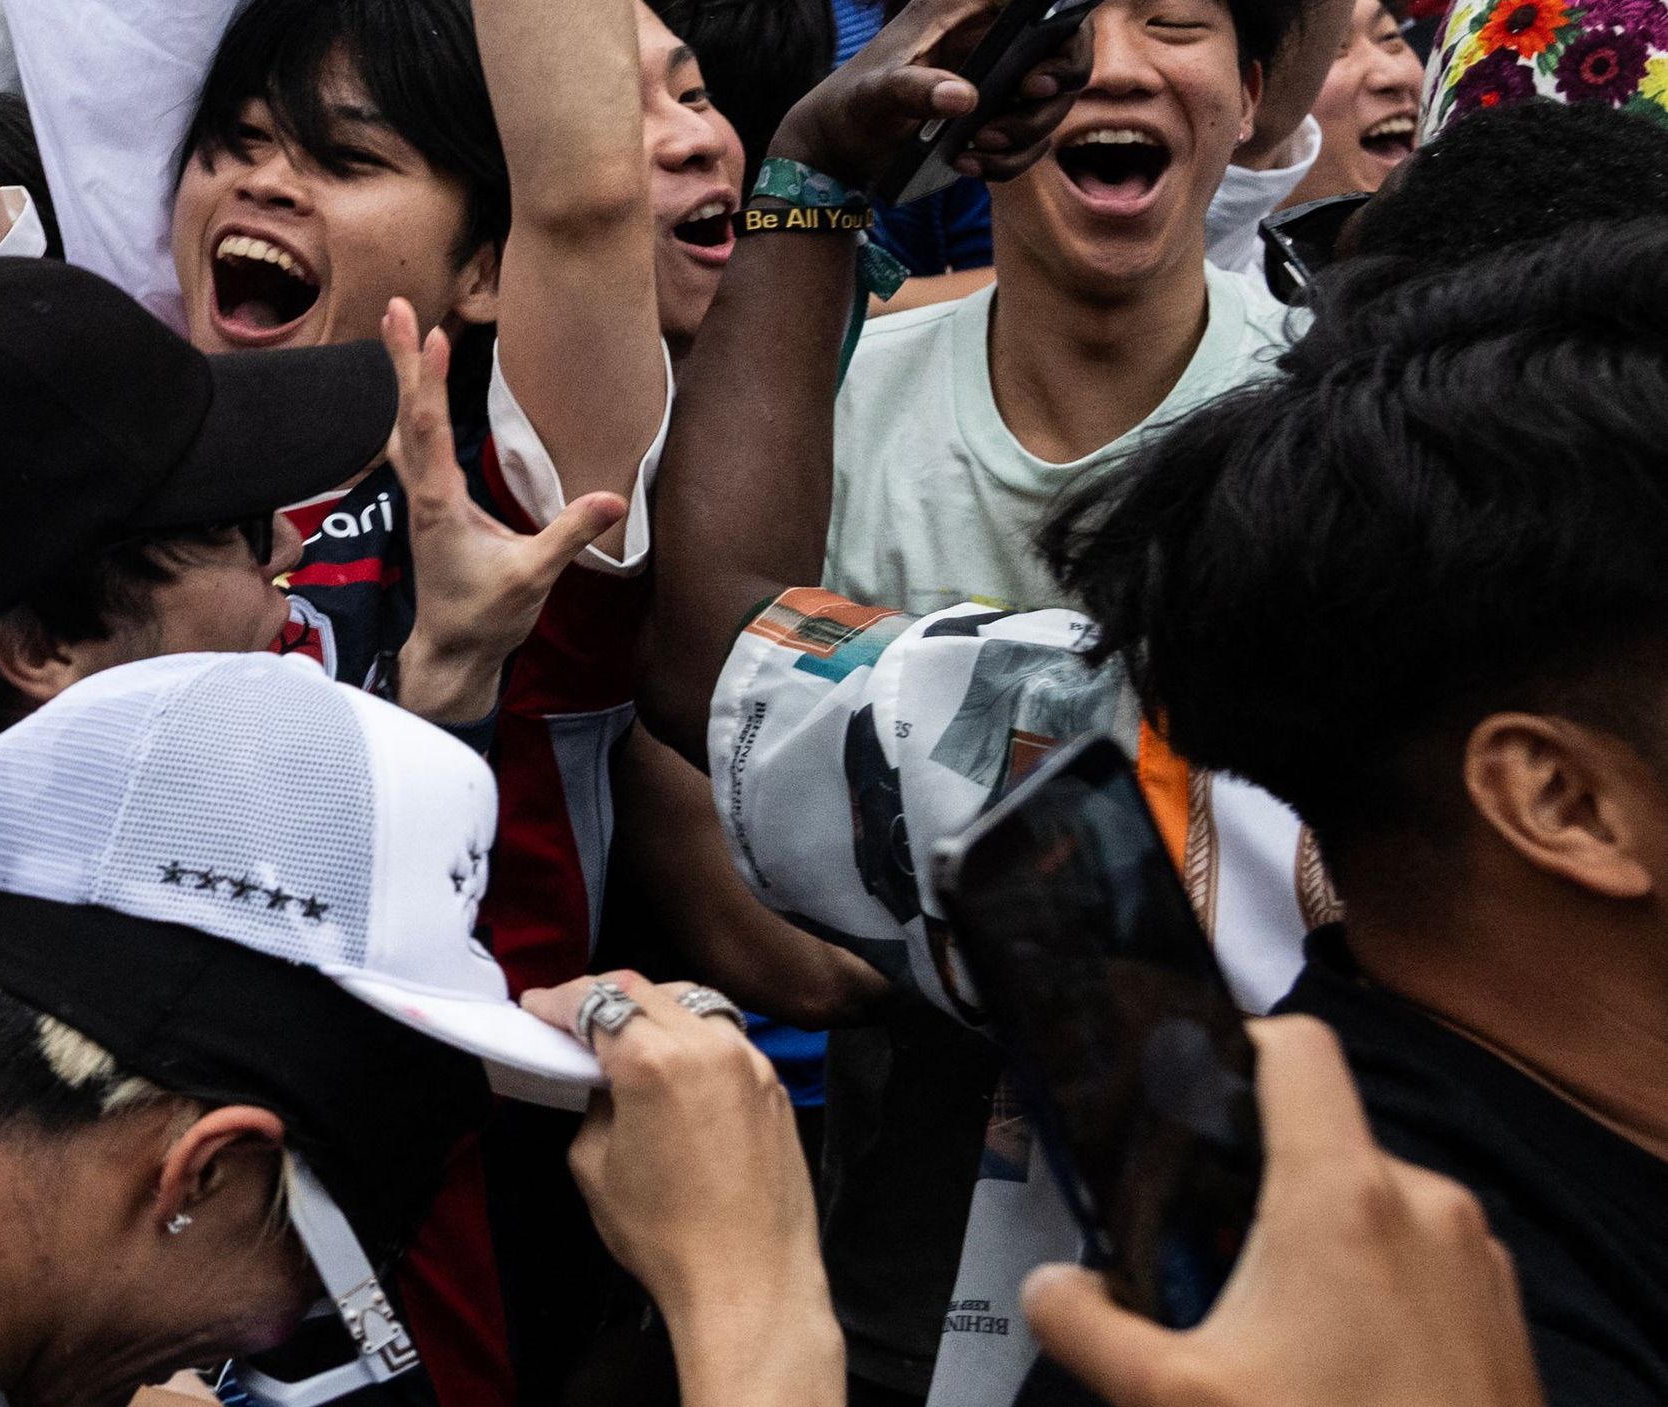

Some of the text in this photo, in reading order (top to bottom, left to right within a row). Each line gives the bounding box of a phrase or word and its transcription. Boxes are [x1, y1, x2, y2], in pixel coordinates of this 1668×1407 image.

[746, 210, 780, 231] Be
[785, 208, 819, 229] All
[943, 1314, 1010, 1335] BEHIN
